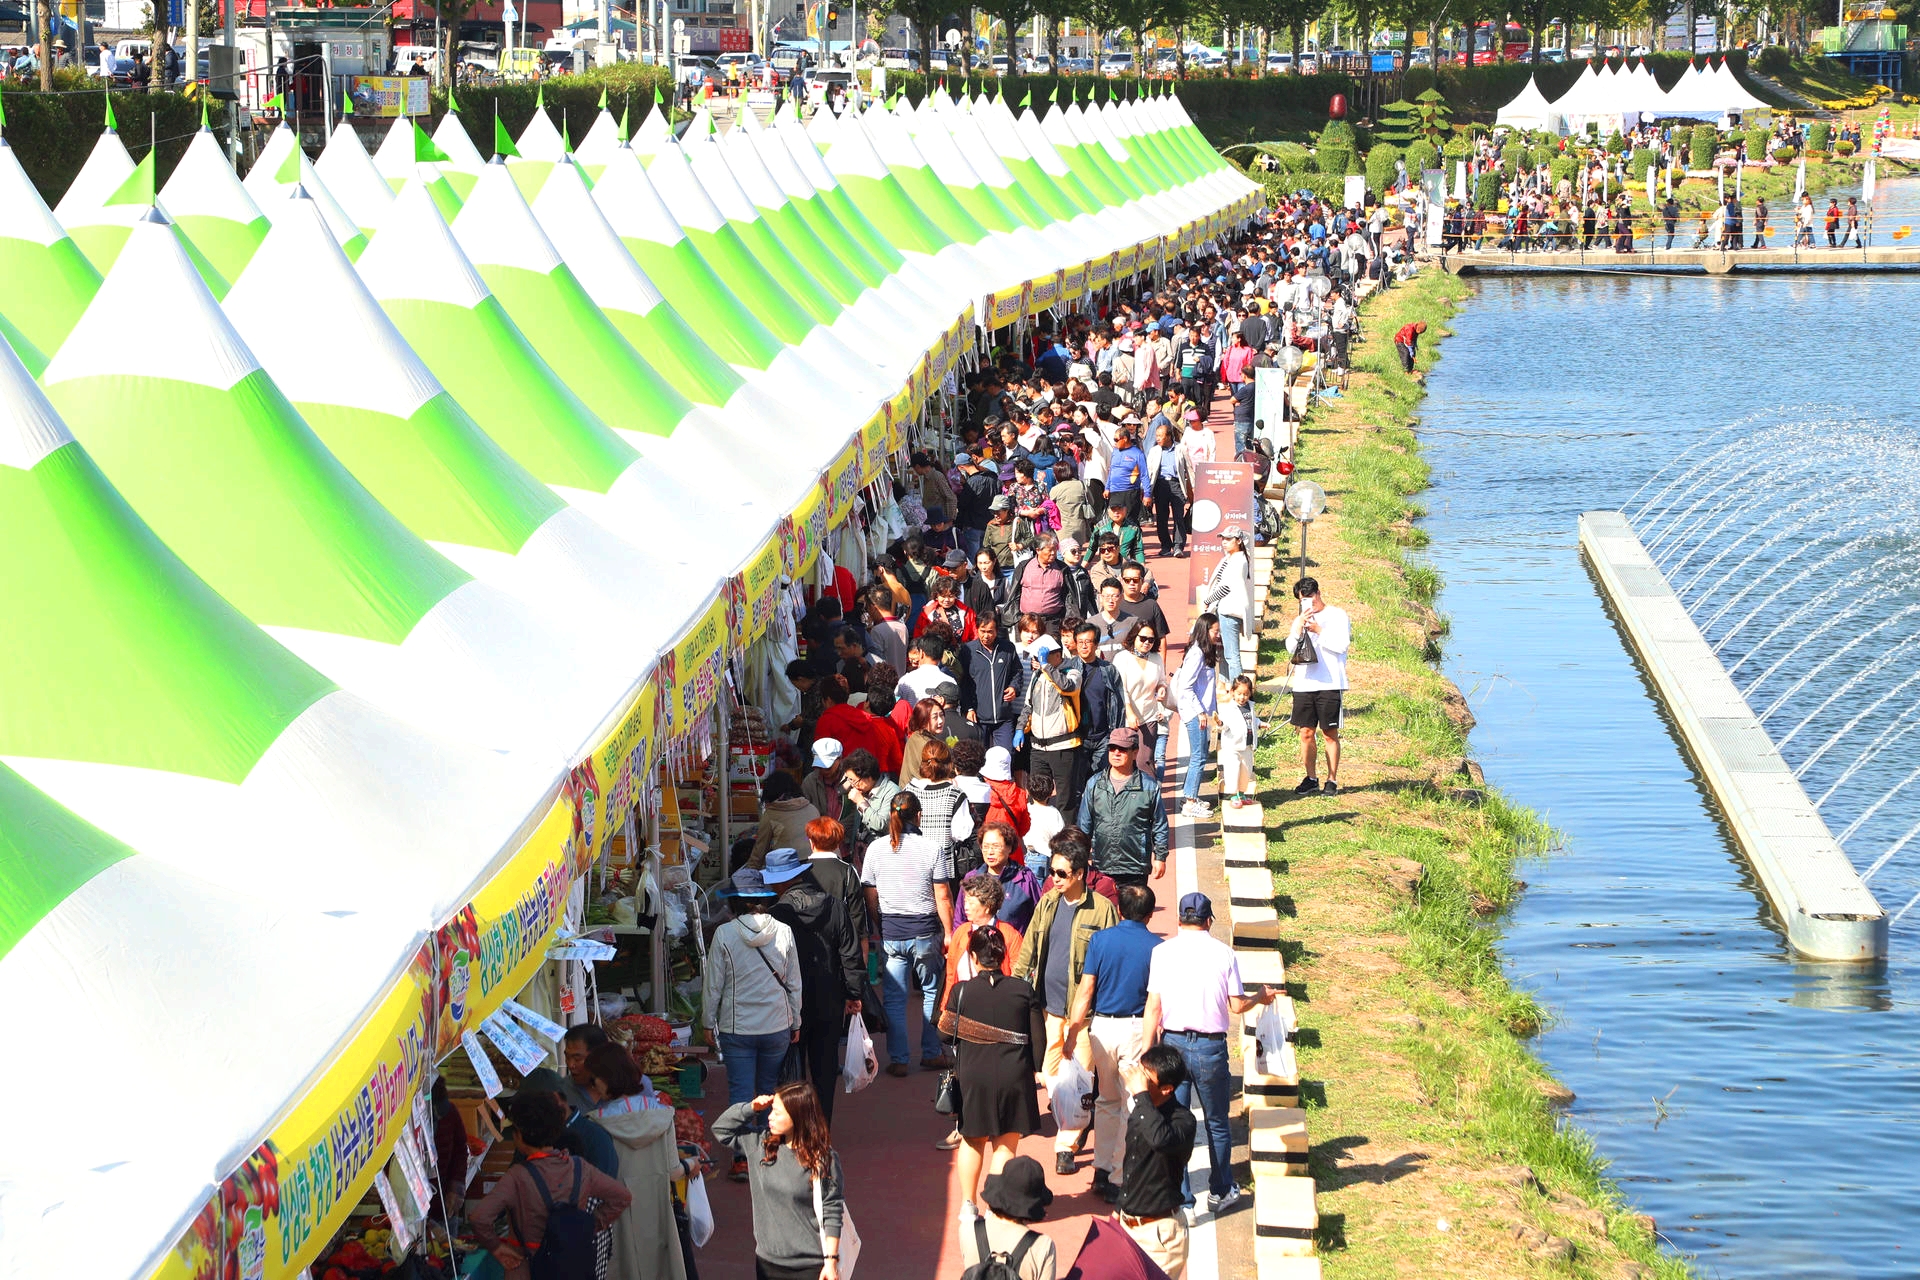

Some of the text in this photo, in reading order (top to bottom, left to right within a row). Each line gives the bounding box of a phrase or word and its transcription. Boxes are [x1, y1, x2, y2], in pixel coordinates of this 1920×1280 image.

[500, 908, 520, 976] 청정
[278, 1159, 311, 1267] 싱싱한
[309, 1135, 332, 1228] 청정
